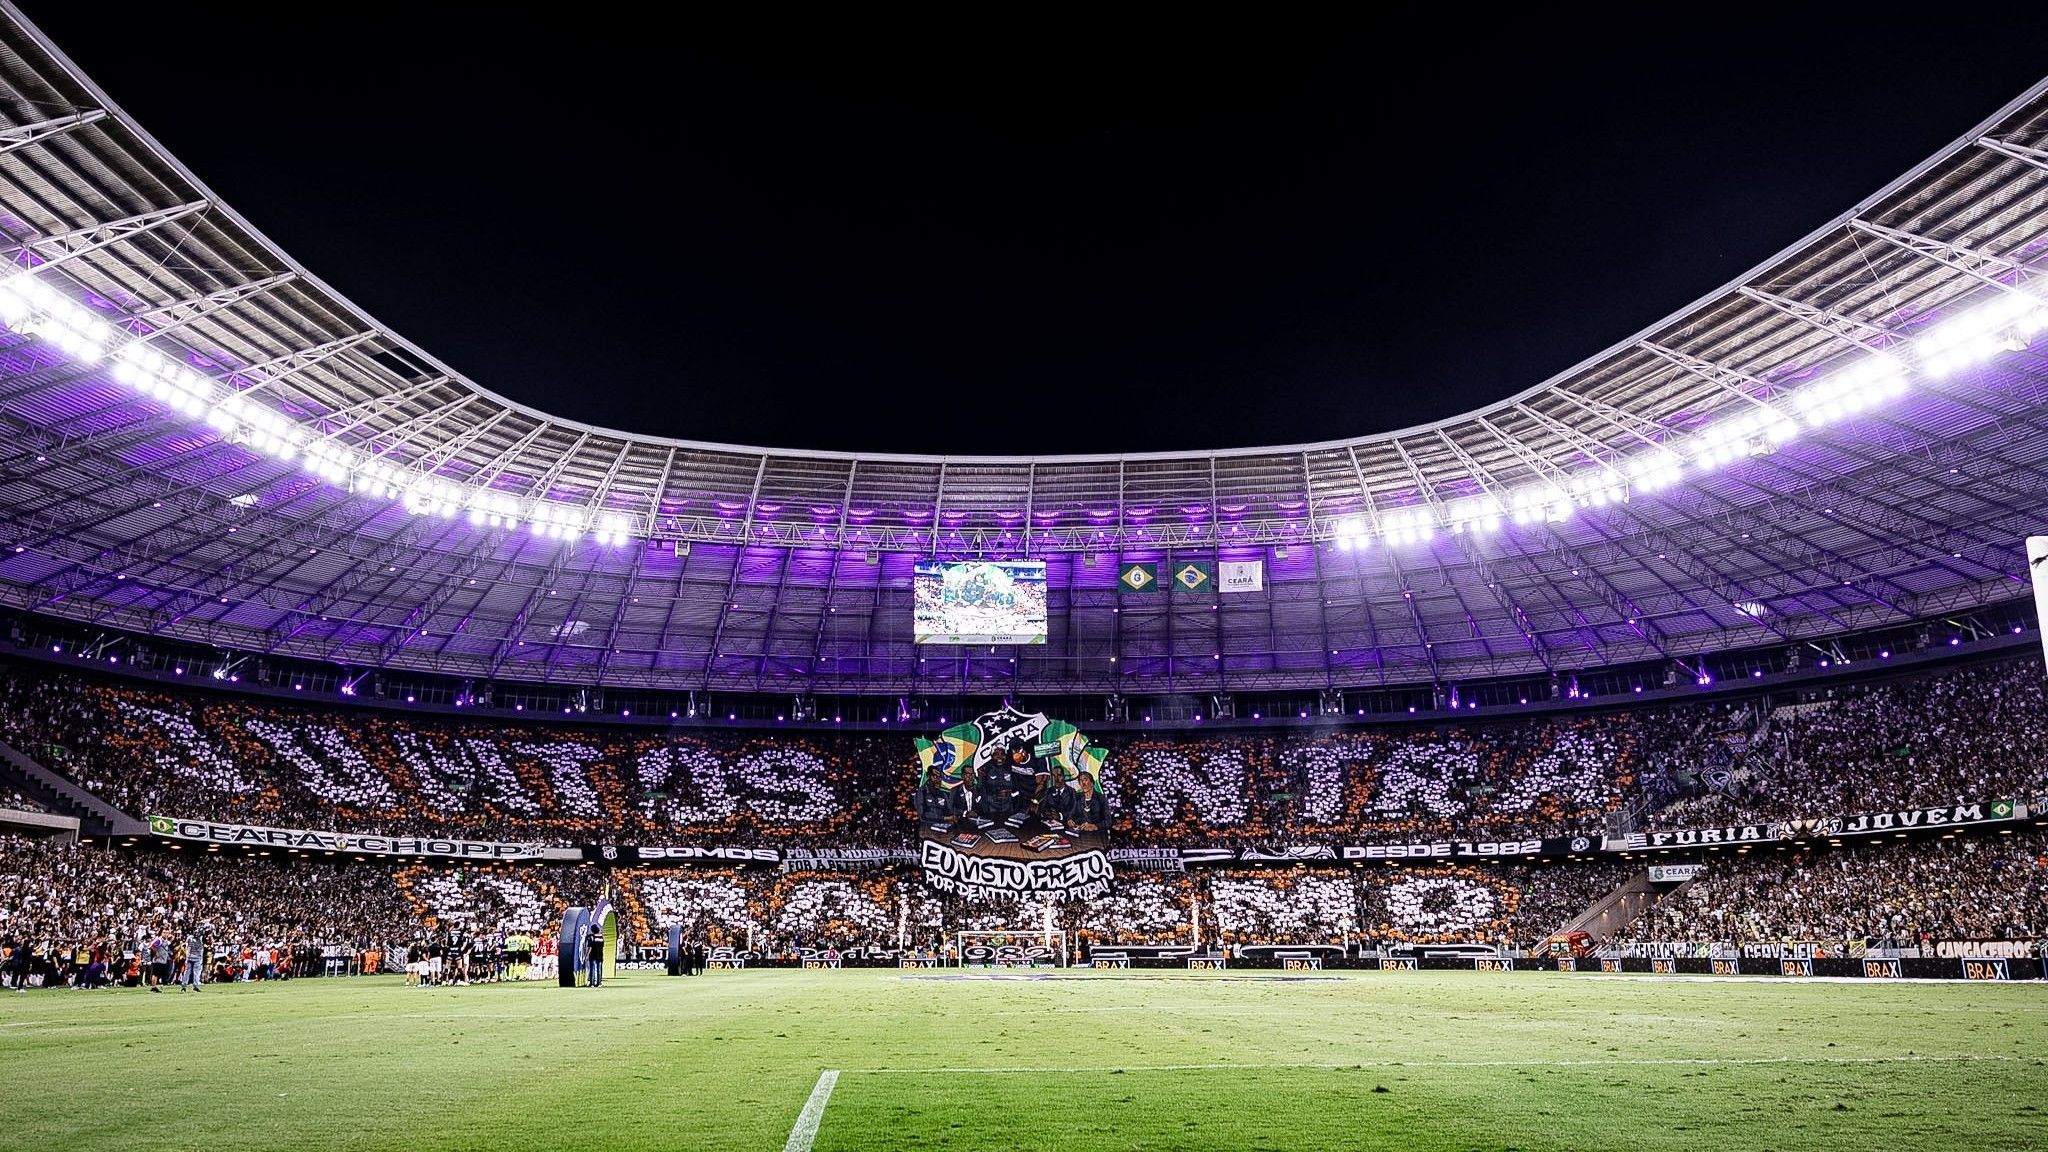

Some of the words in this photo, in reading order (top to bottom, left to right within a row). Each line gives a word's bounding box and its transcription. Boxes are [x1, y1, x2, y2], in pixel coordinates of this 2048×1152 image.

[1227, 575, 1254, 584] CEARÁ
[1652, 826, 1761, 846] FURIA
[1847, 804, 1984, 832] JOVEM
[358, 838, 524, 858] CHOPP
[839, 848, 889, 860] MUNDO
[1342, 844, 1452, 859] DESDE
[1457, 840, 1543, 857] 1982
[638, 847, 779, 862] SOMOS
[959, 855, 1027, 889] VISTO
[1666, 865, 1697, 876] CEARÁ
[926, 870, 954, 894] POR
[452, 936, 459, 946] 9
[1936, 941, 2033, 959] CANGACEIROS
[626, 961, 639, 970] da
[639, 961, 666, 970] Sorte
[709, 961, 741, 969] BRAX
[806, 961, 840, 969] BRAX
[902, 961, 935, 969] BRAX
[1095, 959, 1127, 969] BRAX
[1191, 959, 1223, 969] BRAX
[1287, 959, 1319, 970] BRAX
[1382, 958, 1416, 970] BRAX
[1477, 958, 1512, 970] BRAX
[1559, 960, 1575, 972] BRAX
[1602, 960, 1620, 973] BRAX
[1654, 960, 1674, 974] BRAX
[1713, 960, 1737, 975] BRAX
[1783, 962, 1811, 976] BRAX
[1866, 961, 1899, 978] BRAX
[1966, 962, 2007, 980] BRAX
